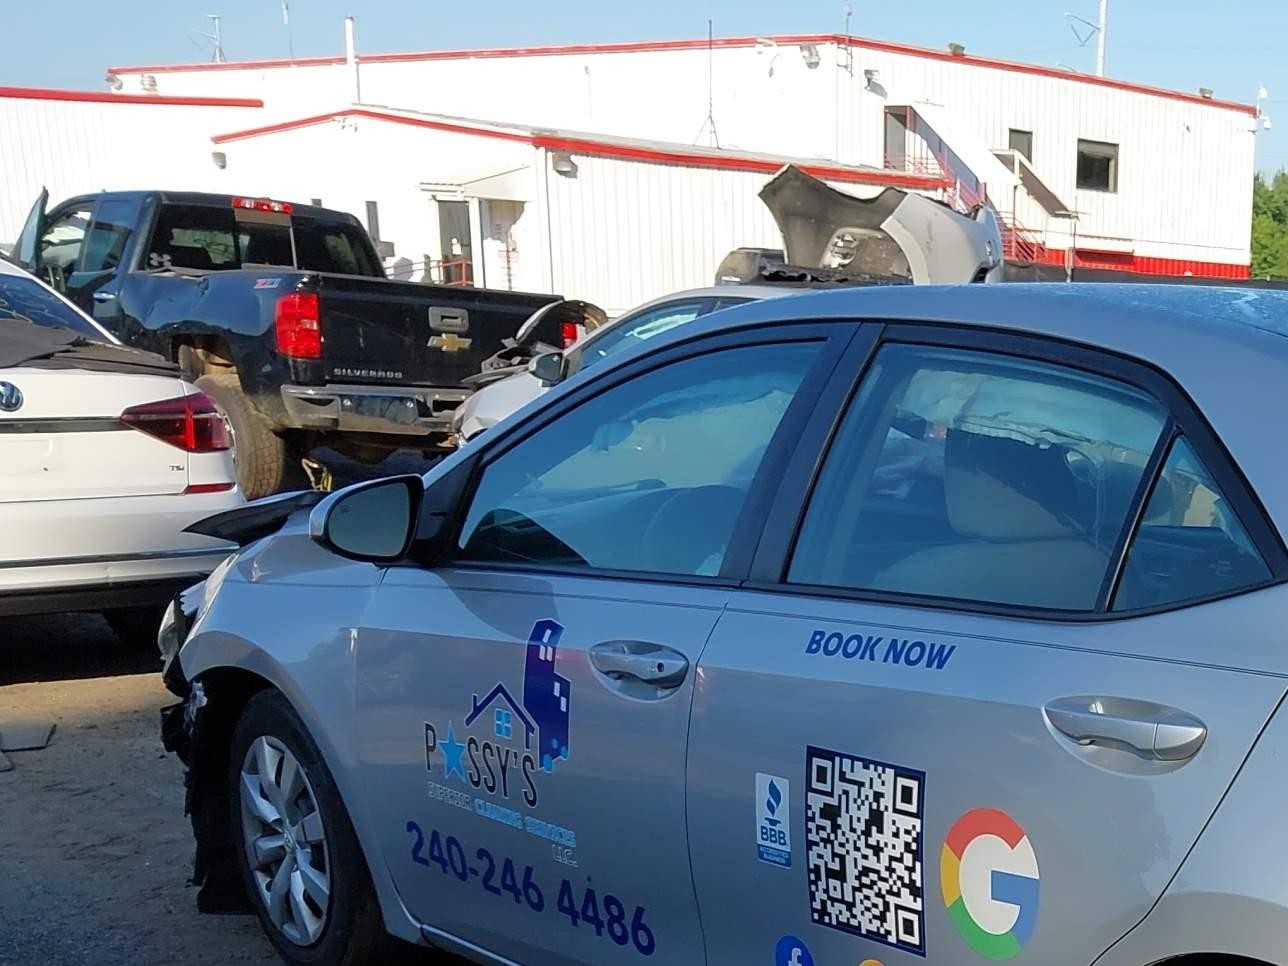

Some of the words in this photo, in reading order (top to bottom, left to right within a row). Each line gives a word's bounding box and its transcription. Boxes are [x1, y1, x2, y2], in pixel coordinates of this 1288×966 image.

[333, 367, 403, 379] SILVERADO
[805, 630, 883, 662] BOOK
[883, 638, 957, 670] NOW
[760, 825, 787, 846] BBB
[406, 821, 546, 913] 240-246
[556, 879, 656, 956] 4486
